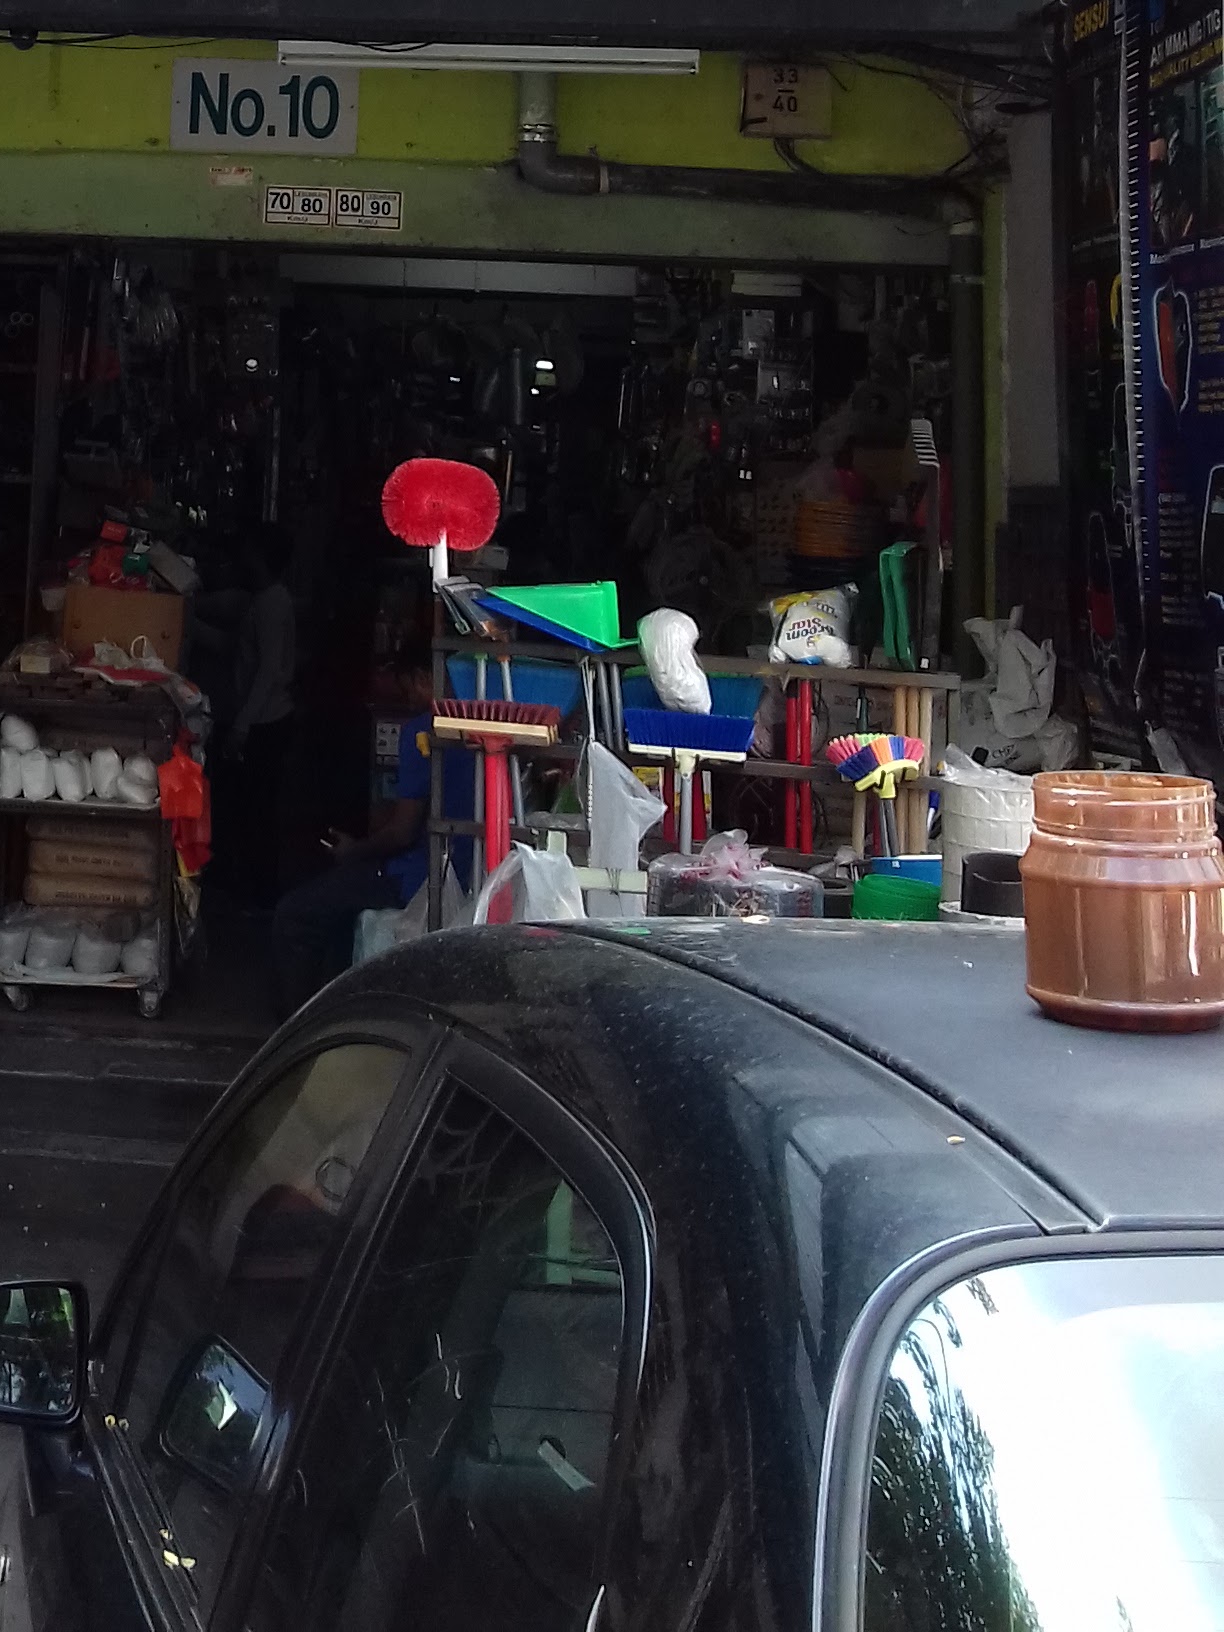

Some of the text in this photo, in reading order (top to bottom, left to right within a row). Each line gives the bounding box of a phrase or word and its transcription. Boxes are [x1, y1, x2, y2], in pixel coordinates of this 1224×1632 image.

[773, 68, 799, 84] 33
[189, 71, 339, 139] No.10
[772, 95, 798, 113] 40
[269, 191, 291, 210] 70
[301, 198, 323, 213] 80
[339, 194, 361, 213] 80
[370, 200, 392, 216] 90
